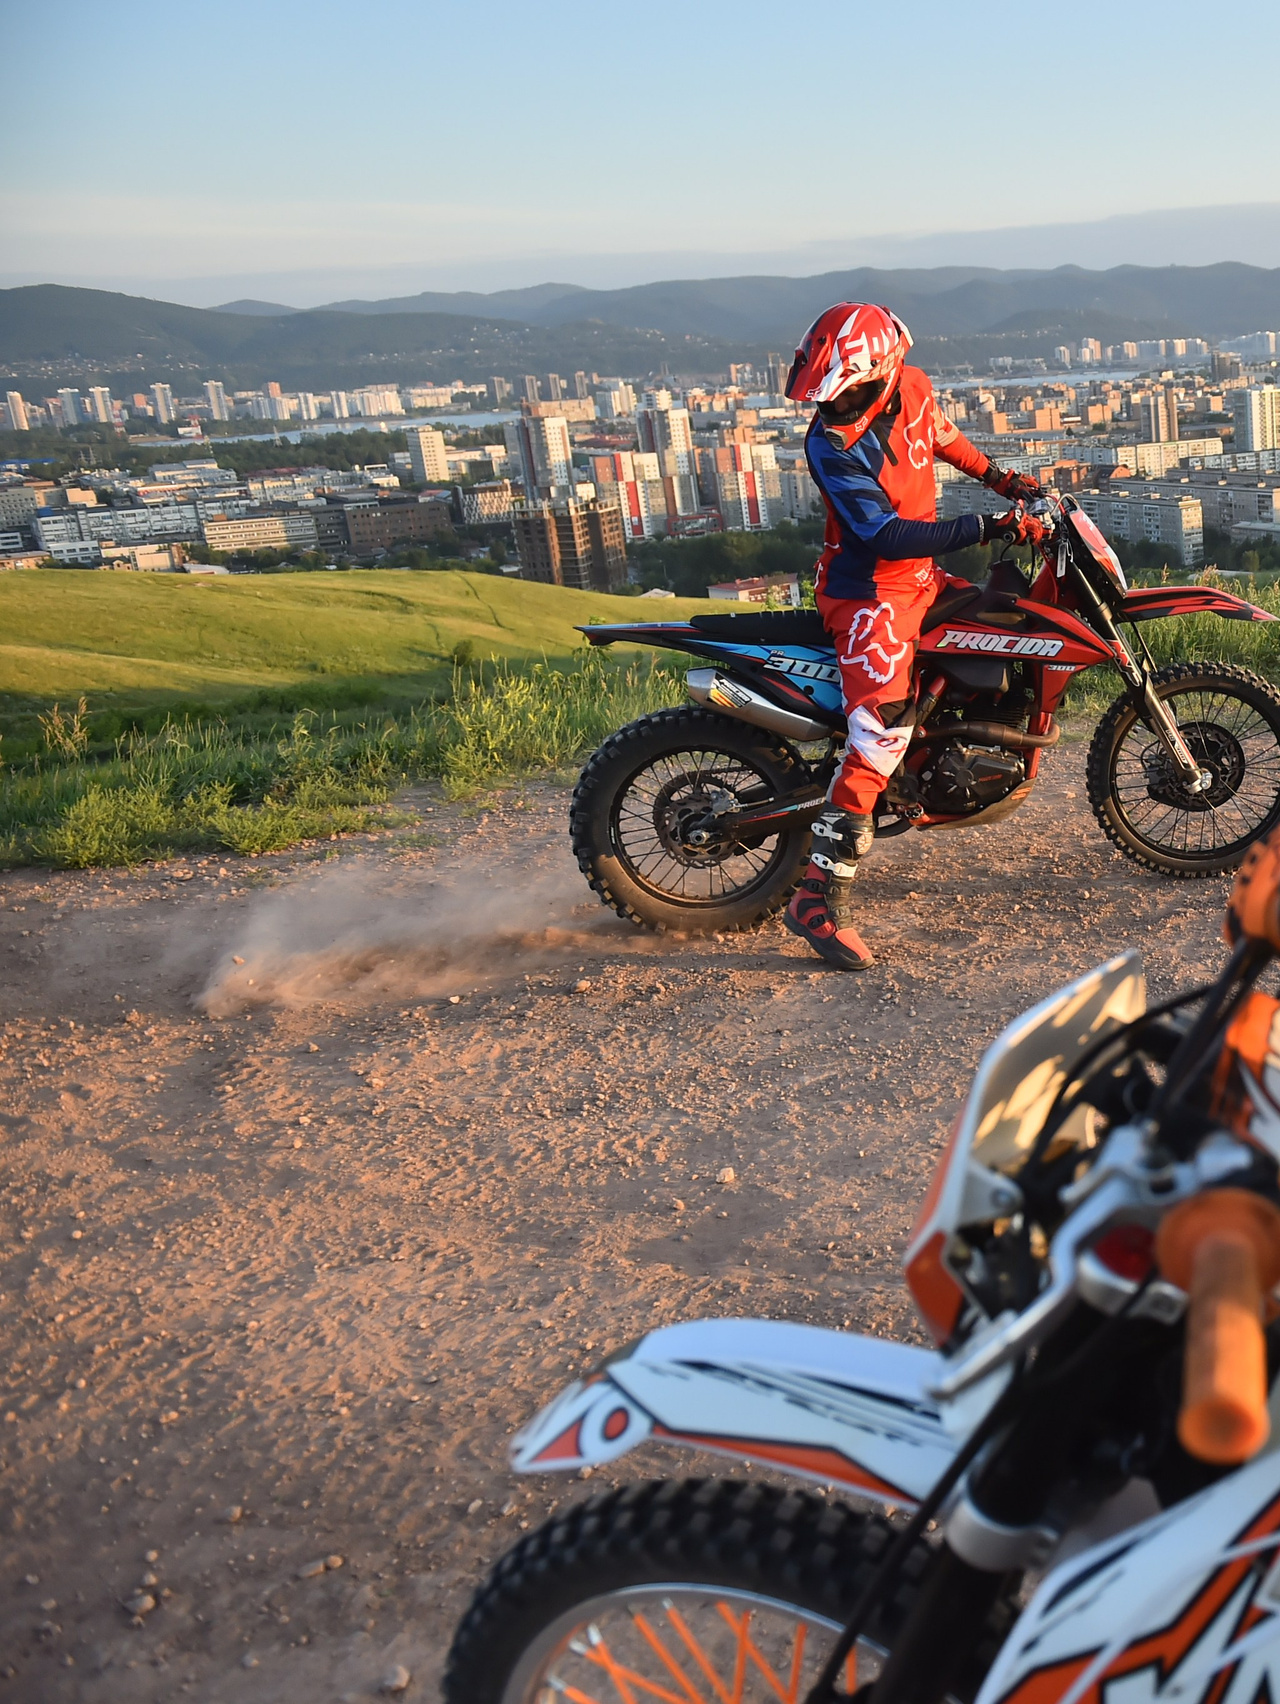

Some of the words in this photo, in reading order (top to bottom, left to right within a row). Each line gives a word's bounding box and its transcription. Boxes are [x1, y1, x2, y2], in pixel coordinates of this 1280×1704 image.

[936, 630, 1065, 657] PROCIDA
[763, 656, 840, 684] 300
[1047, 664, 1076, 672] 300
